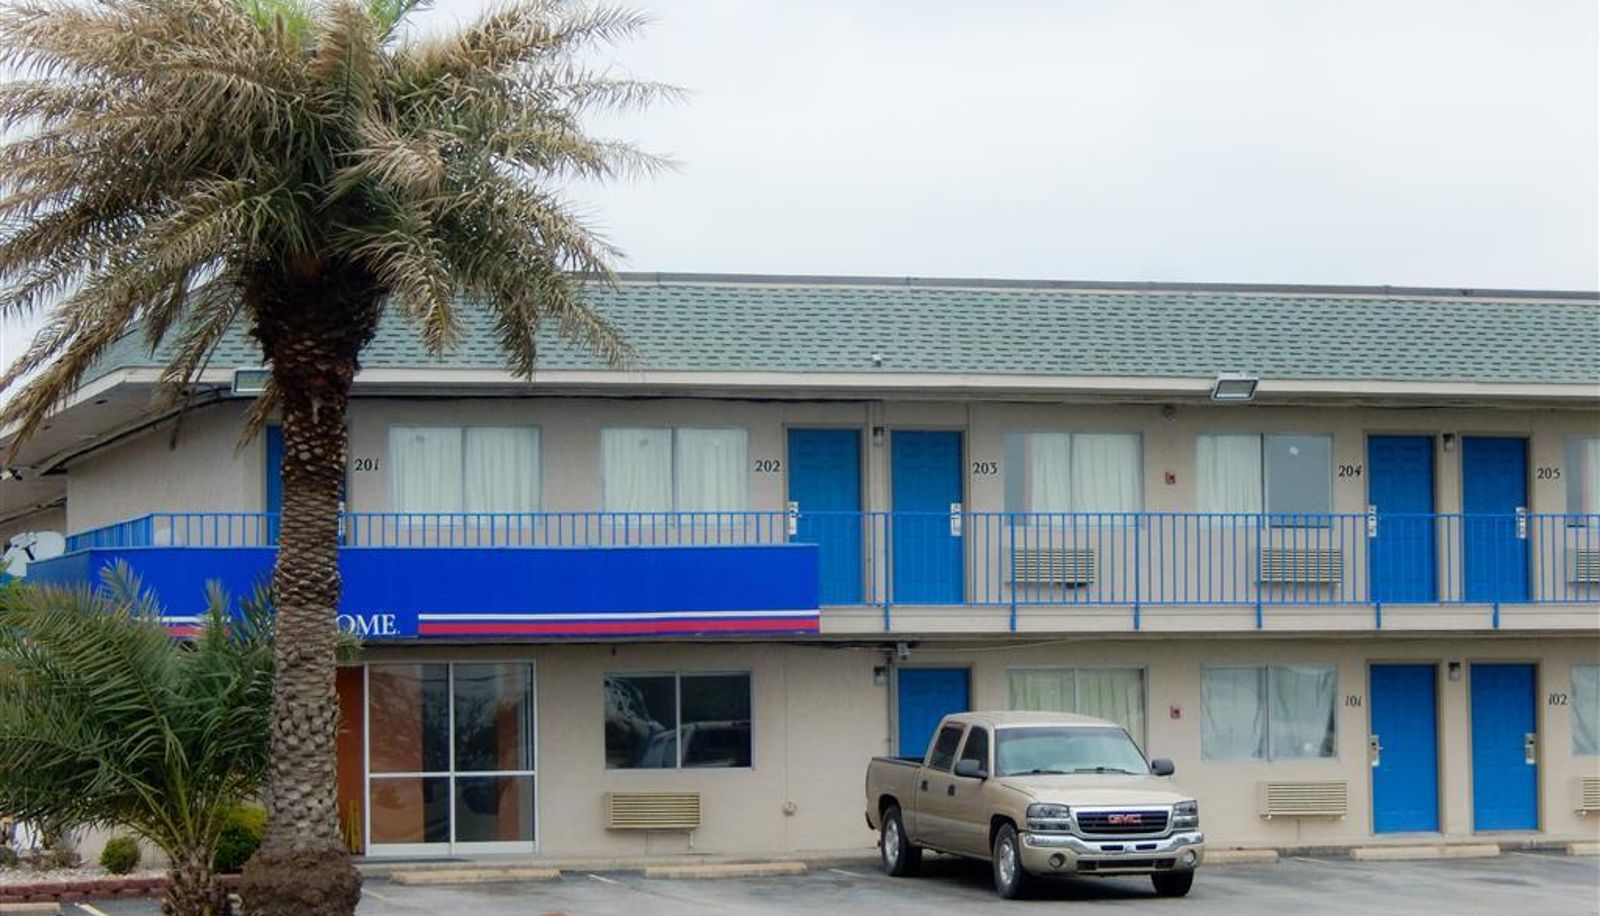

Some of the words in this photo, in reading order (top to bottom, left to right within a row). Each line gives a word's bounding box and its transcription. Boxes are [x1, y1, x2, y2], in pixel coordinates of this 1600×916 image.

[354, 457, 379, 471] 201
[754, 459, 780, 473] 202
[972, 461, 998, 475] 203
[1338, 464, 1362, 478] 204
[1537, 467, 1561, 480] 205
[336, 614, 400, 636] OME.
[1345, 695, 1362, 707] 101
[1548, 693, 1567, 706] 102
[1107, 814, 1141, 824] GMC
